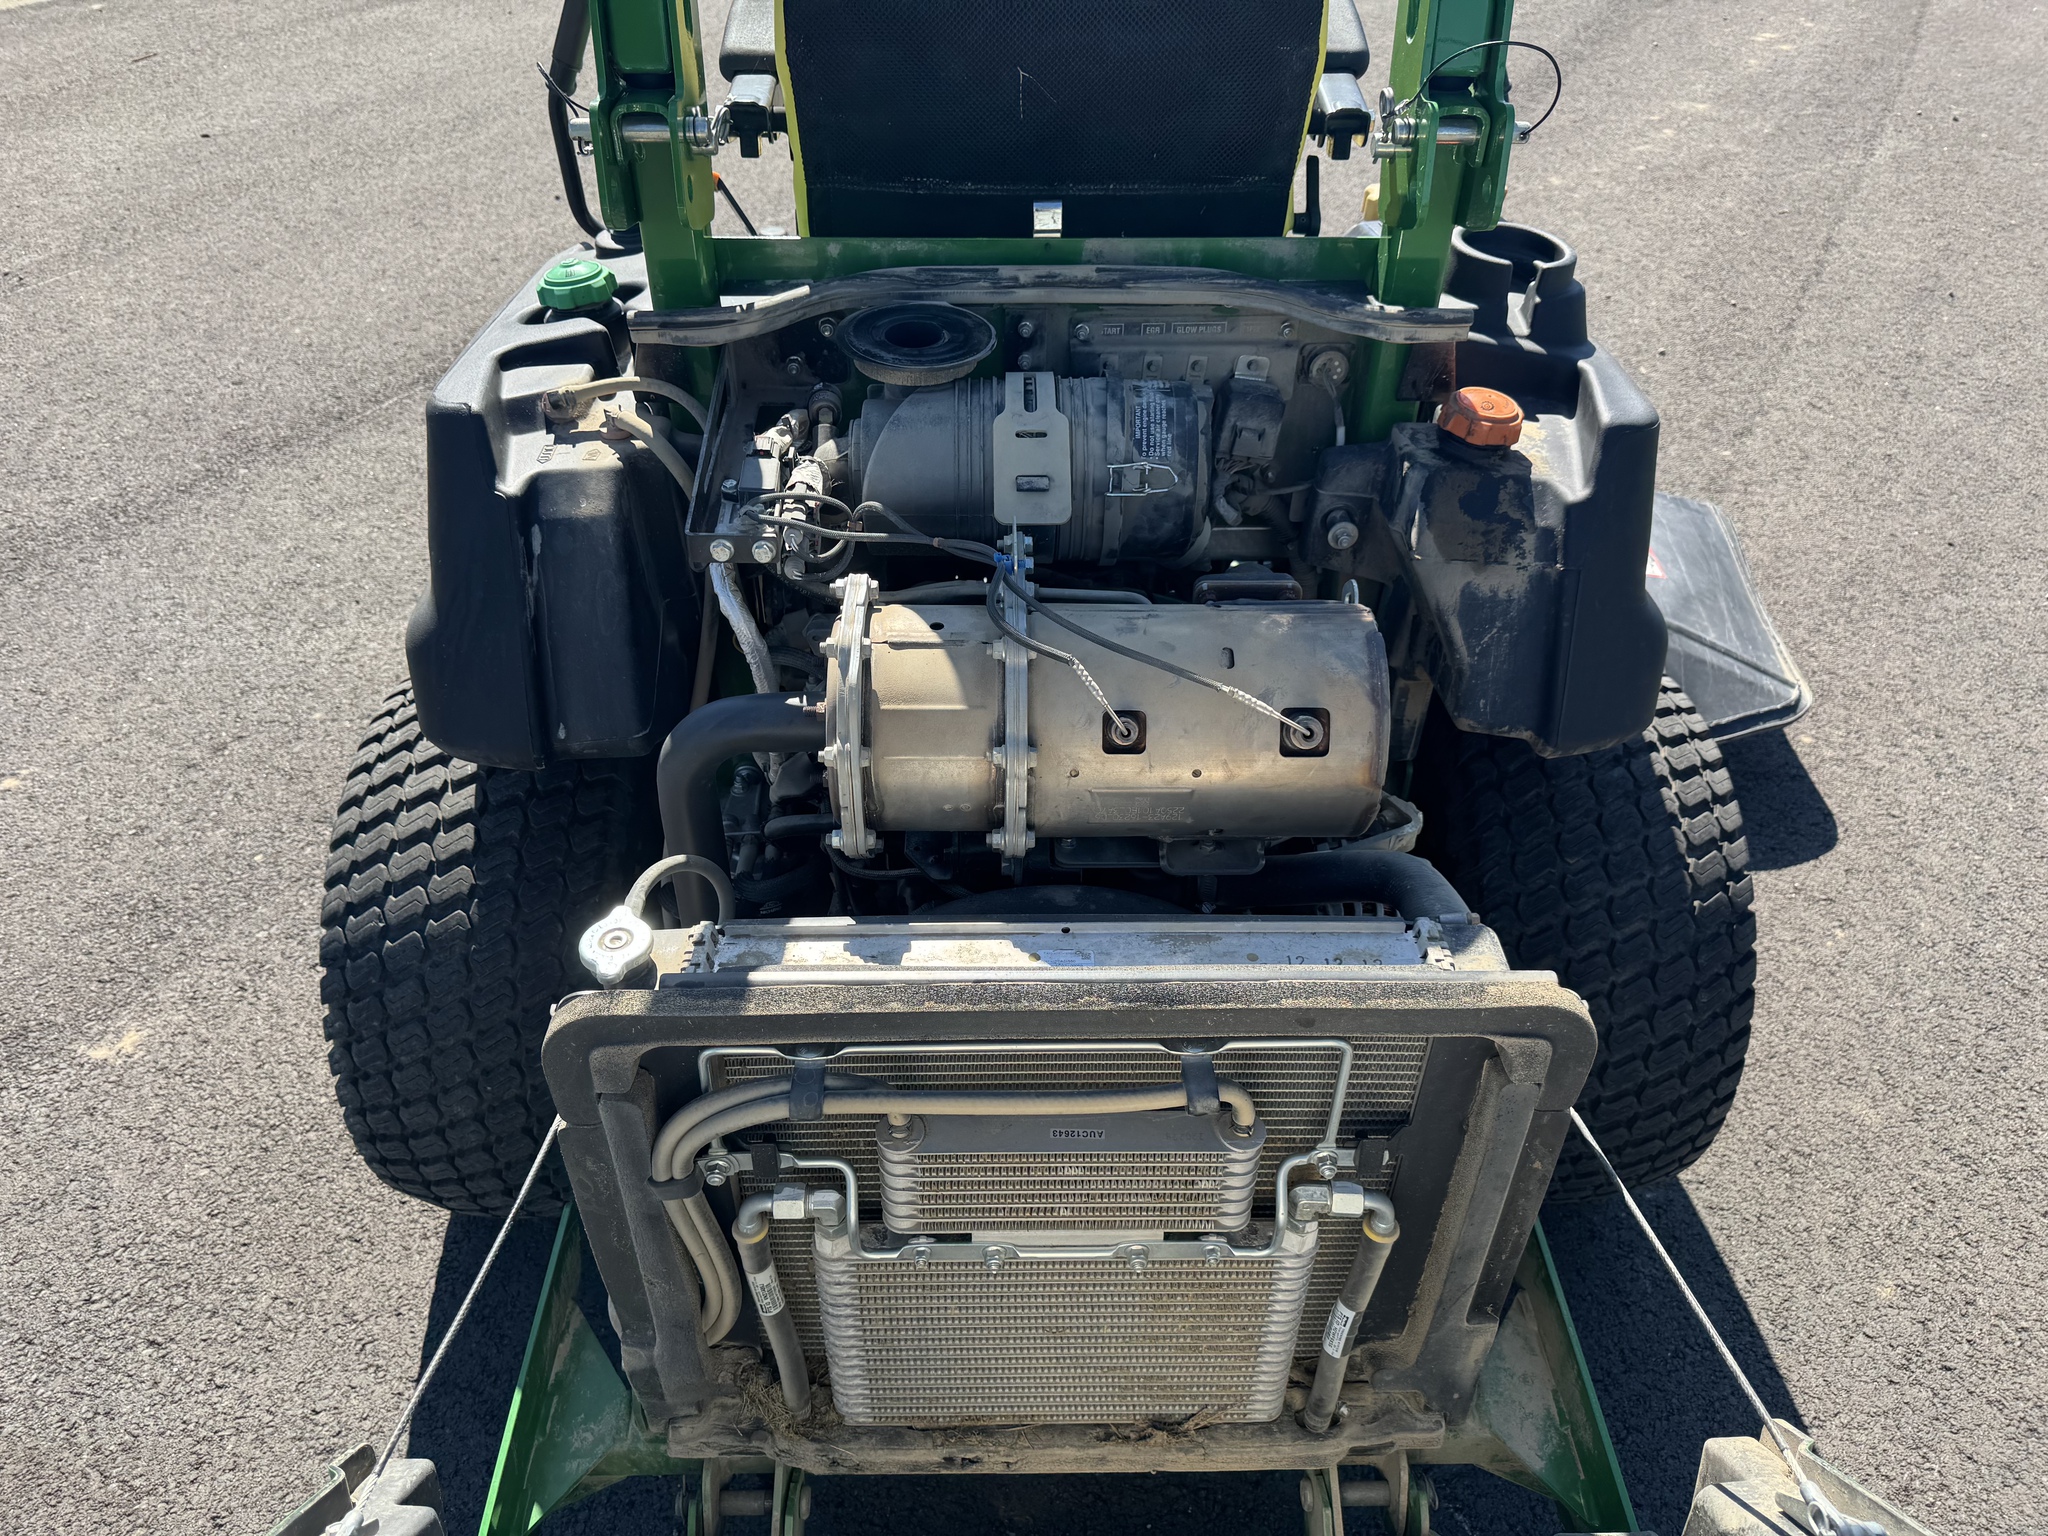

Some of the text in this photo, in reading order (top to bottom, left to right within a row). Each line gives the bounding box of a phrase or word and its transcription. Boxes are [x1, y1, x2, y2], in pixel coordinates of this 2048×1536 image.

[1146, 326, 1161, 335] EGR
[1176, 325, 1222, 334] GLOW PLUGS
[1149, 447, 1155, 457] Do
[1052, 1130, 1104, 1138] AUC12643
